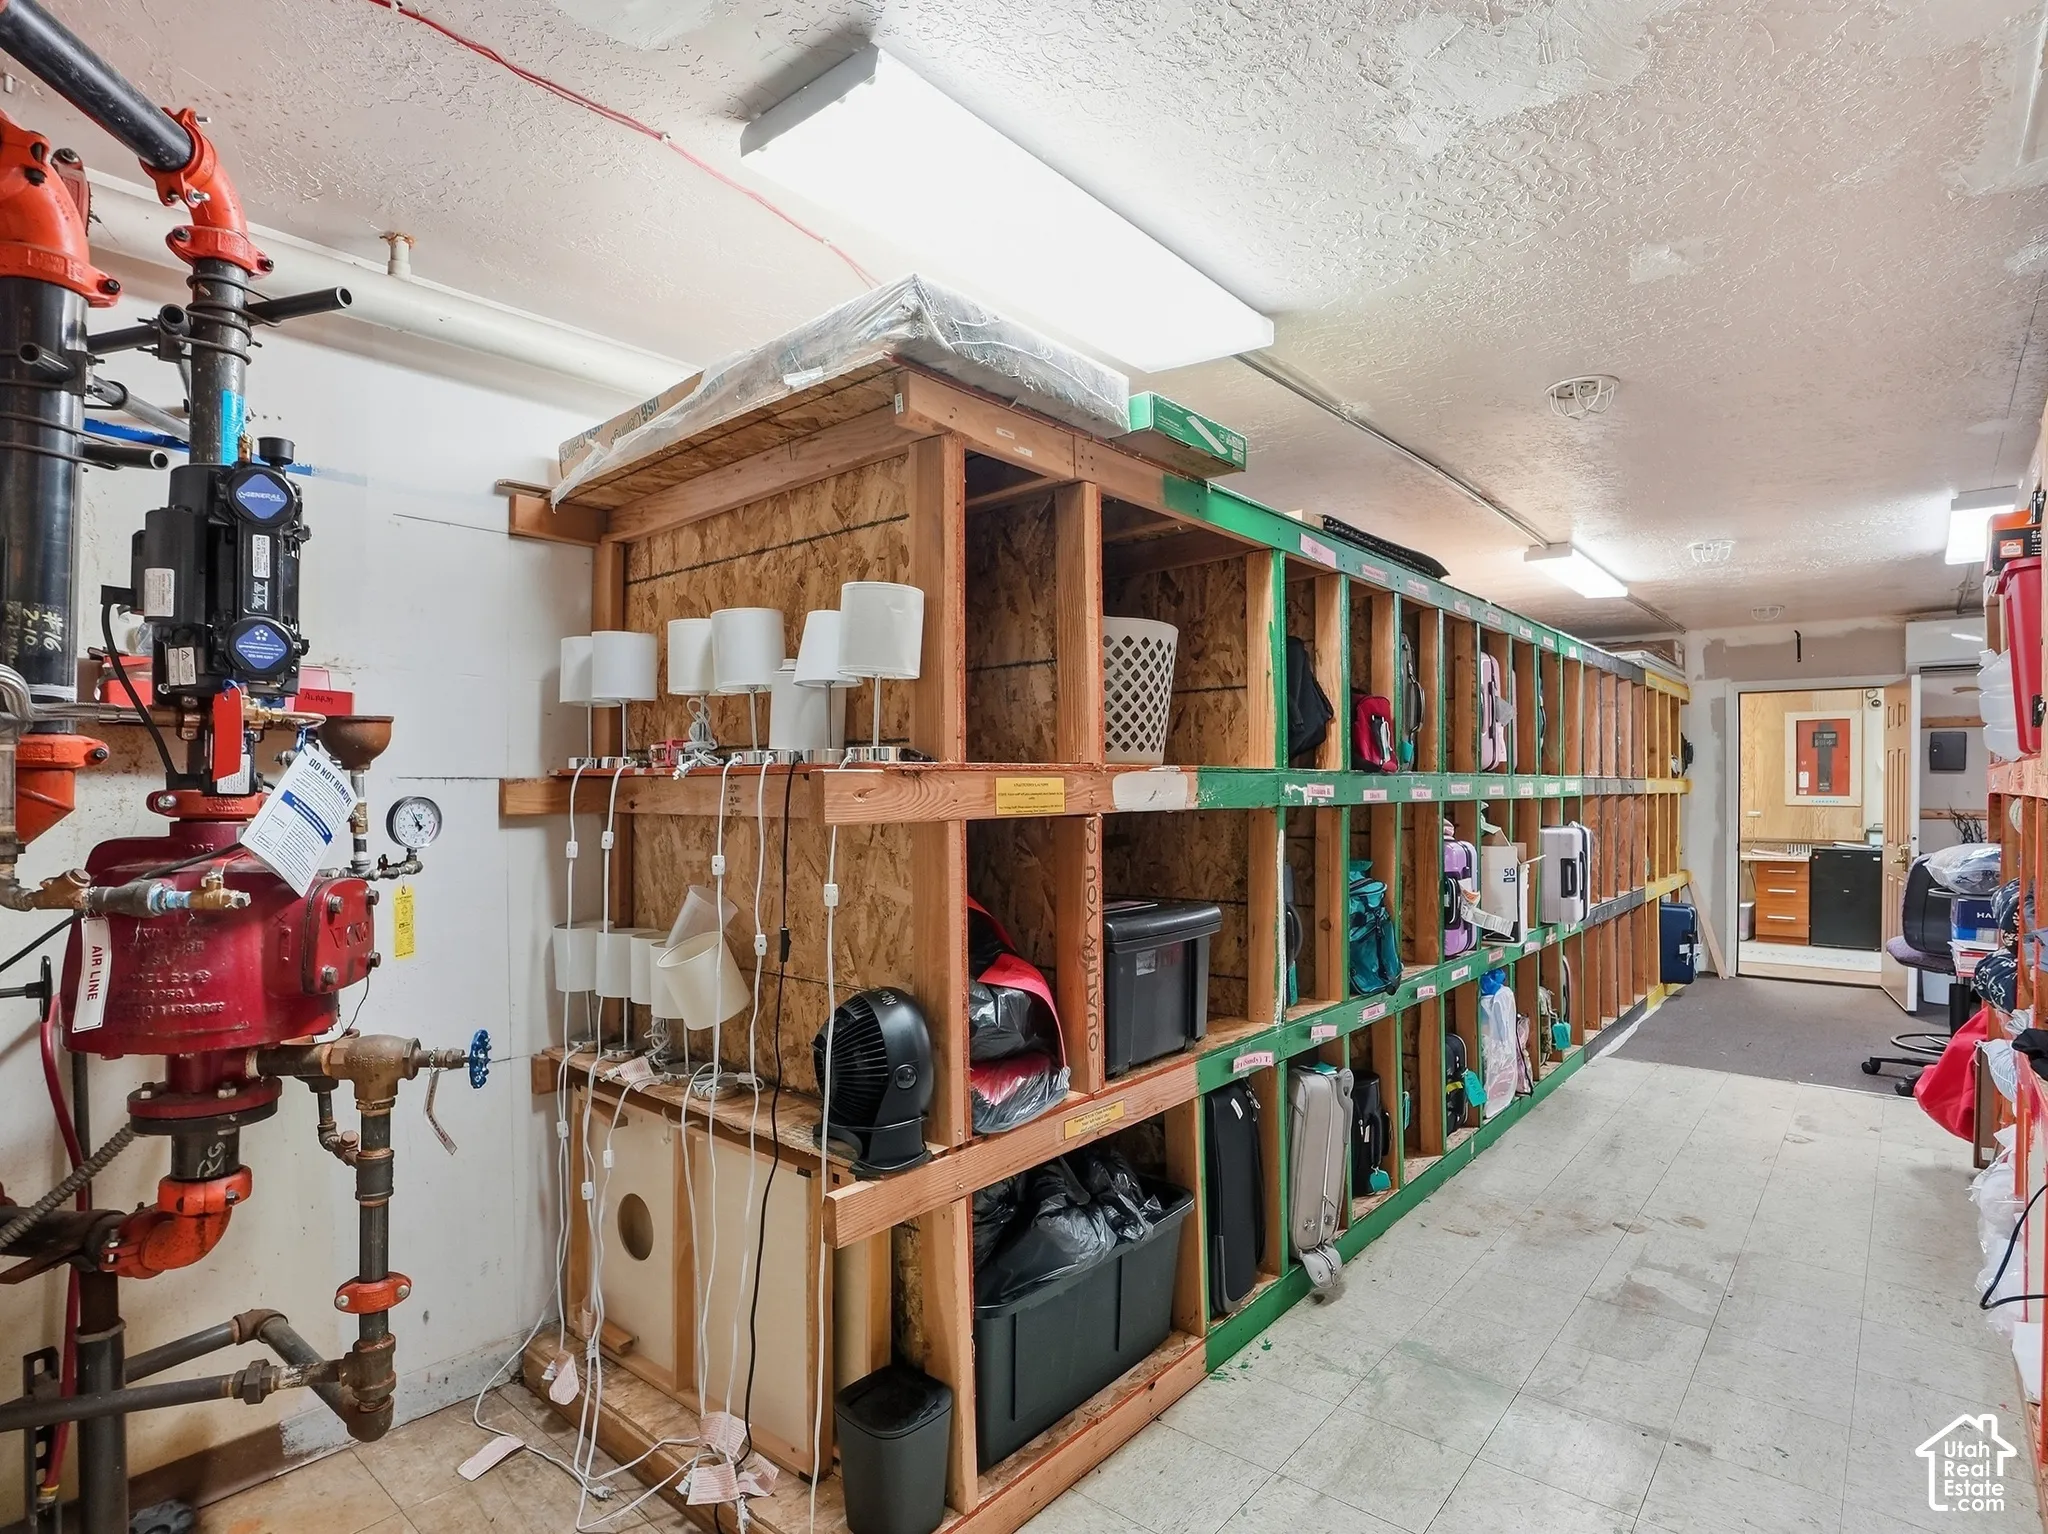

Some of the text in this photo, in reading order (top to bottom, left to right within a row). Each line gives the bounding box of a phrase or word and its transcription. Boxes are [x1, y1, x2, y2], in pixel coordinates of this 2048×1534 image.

[246, 491, 281, 500] GENERAL
[41, 611, 63, 652] #16
[304, 691, 334, 705] ALARM
[309, 758, 322, 771] DO
[320, 767, 335, 783] NOT
[1503, 867, 1515, 877] 50
[1086, 864, 1098, 921] YOU
[87, 945, 103, 1001] AIR LINE
[1084, 935, 1099, 1053] QUALITY
[428, 1115, 448, 1142] DRAIN
